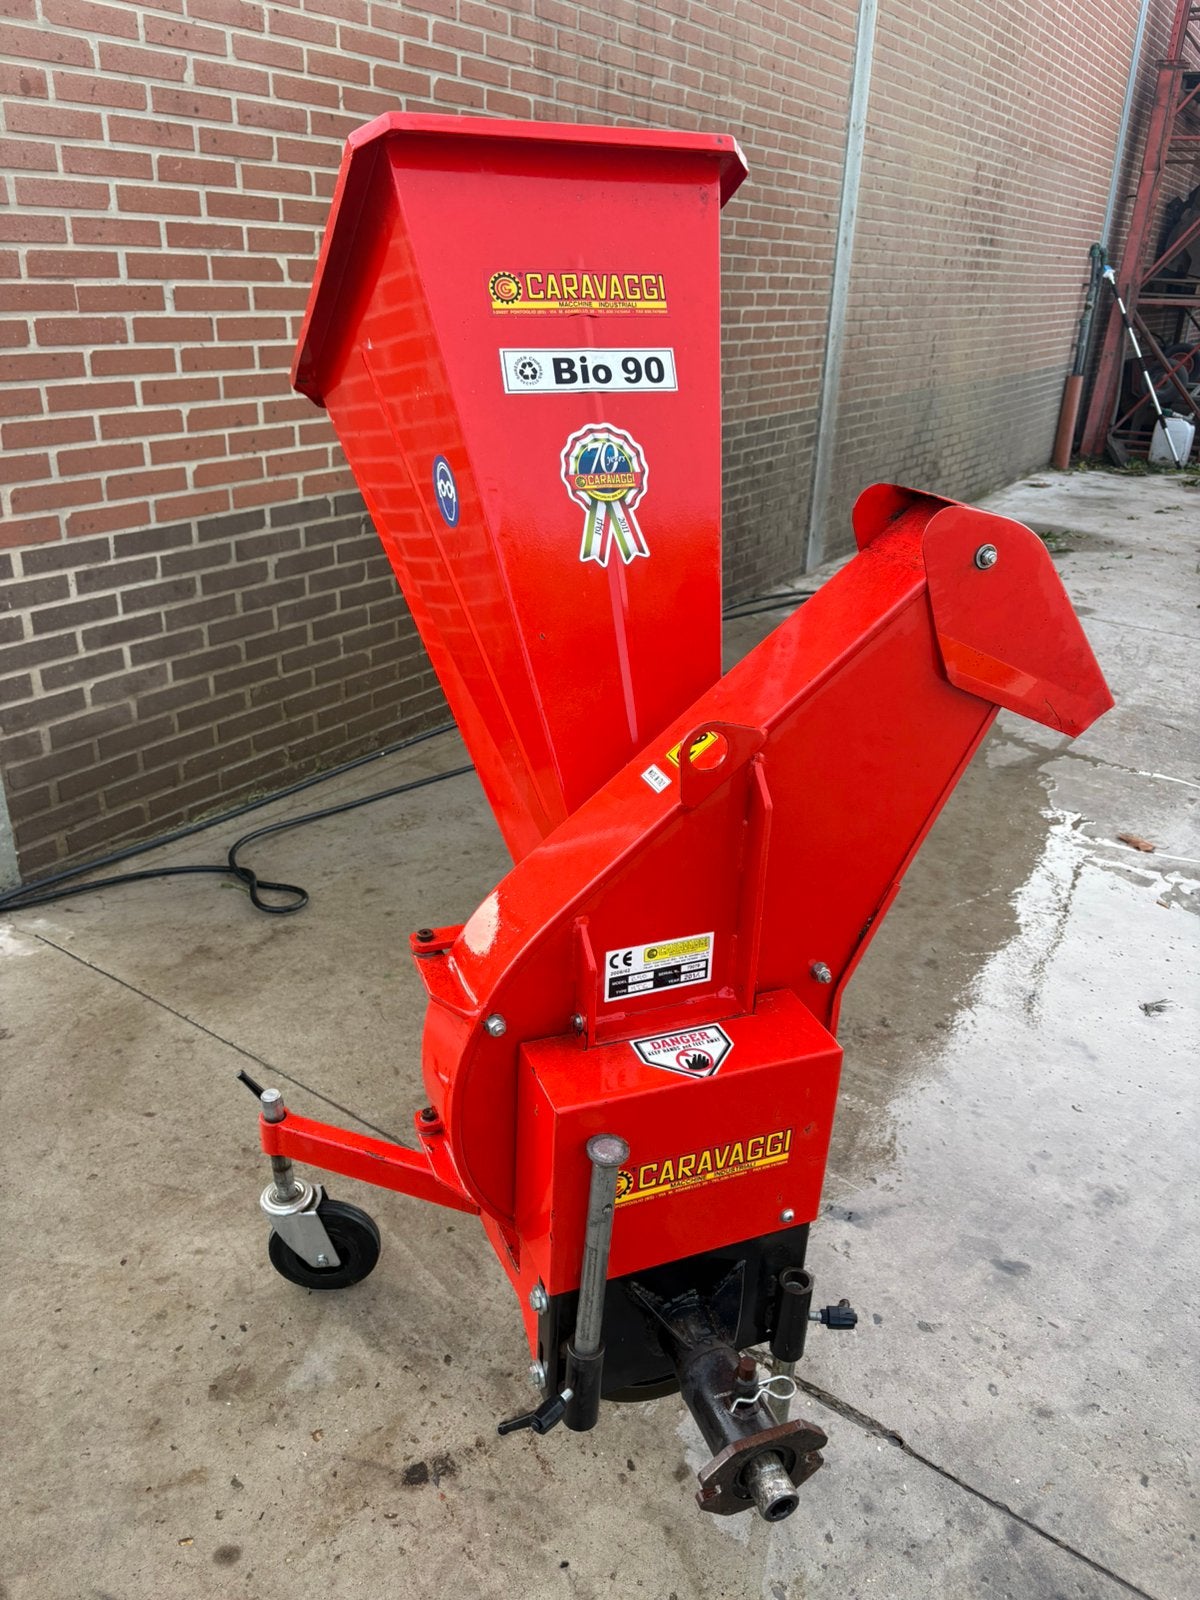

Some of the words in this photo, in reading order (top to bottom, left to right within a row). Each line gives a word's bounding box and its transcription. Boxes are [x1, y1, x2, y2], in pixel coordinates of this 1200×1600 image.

[525, 272, 666, 301] CARAVAGGI
[552, 356, 613, 385] Bio
[621, 356, 665, 384] 90
[587, 442, 619, 474] 70
[606, 455, 626, 466] years
[587, 474, 635, 485] CARAVAGGI
[595, 517, 605, 536] 1941
[618, 517, 630, 534] 2011
[609, 951, 633, 969] CE
[650, 1031, 710, 1050] DANGER
[639, 1129, 792, 1190] CARAVAGGI
[670, 1175, 707, 1188] MACCHINE
[714, 1162, 757, 1177] INDUSTRIALI
